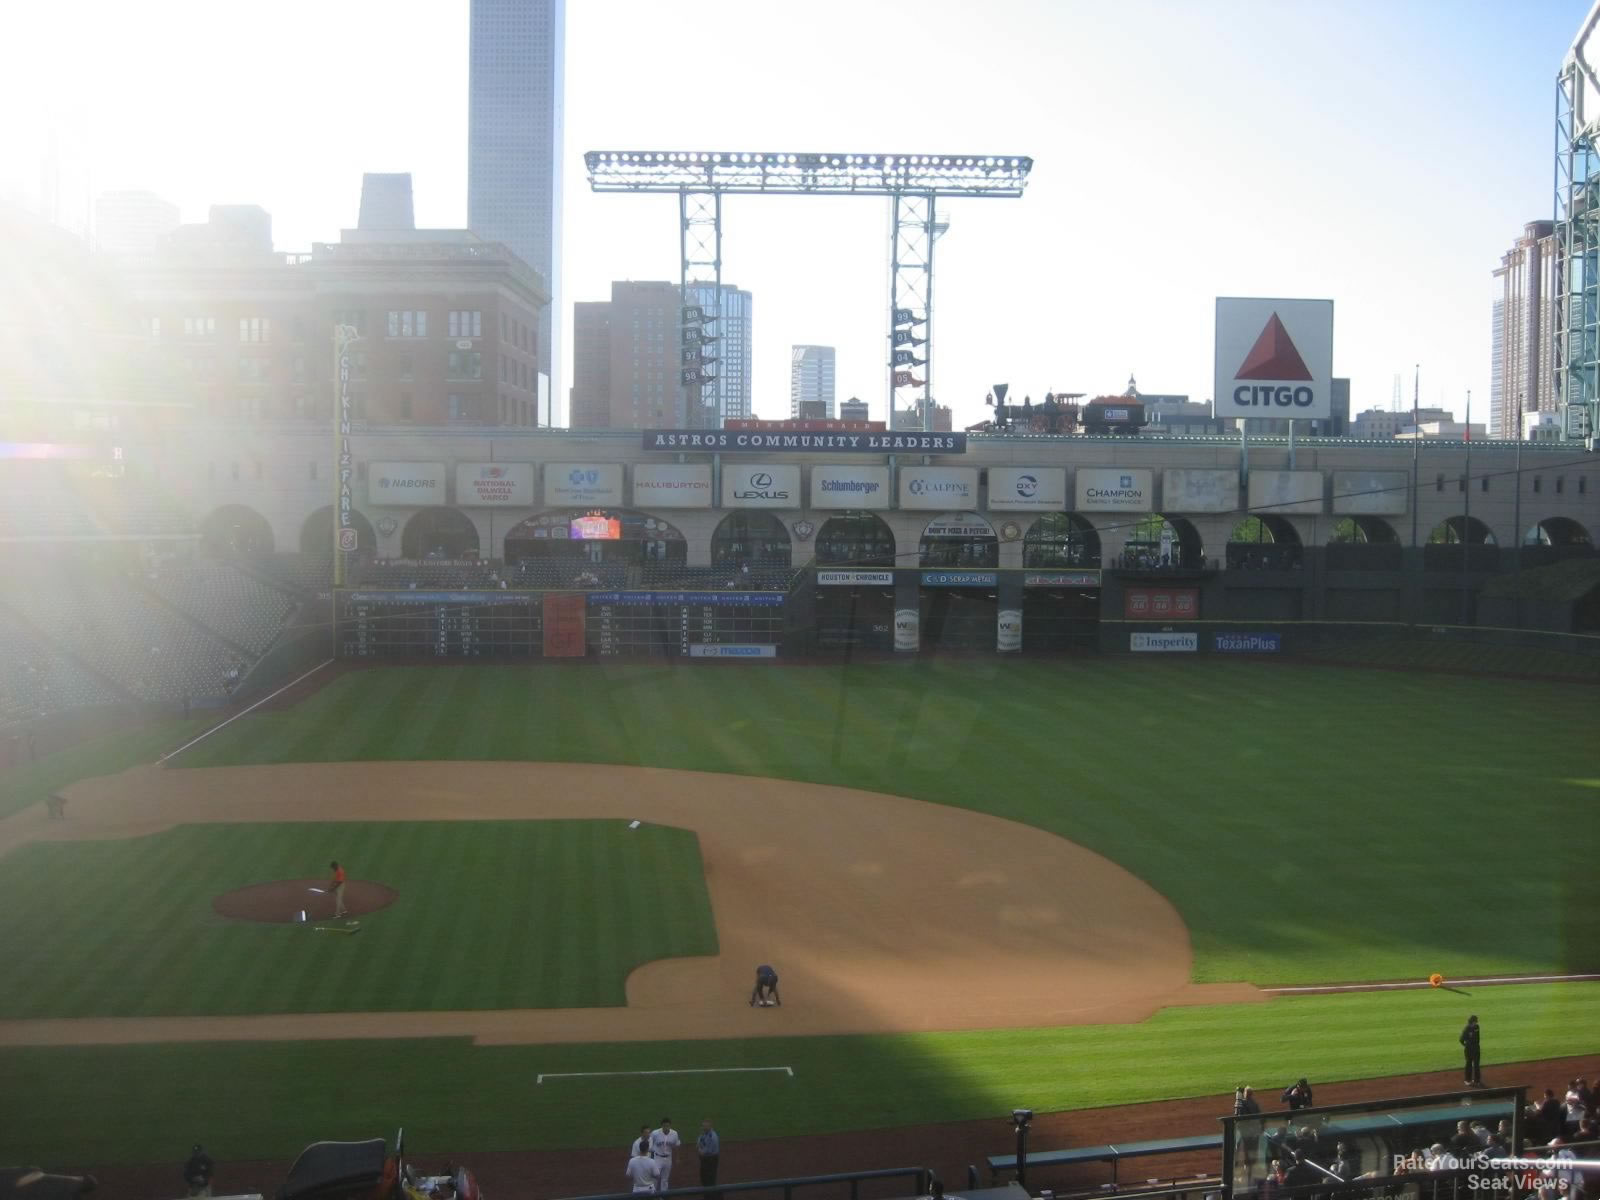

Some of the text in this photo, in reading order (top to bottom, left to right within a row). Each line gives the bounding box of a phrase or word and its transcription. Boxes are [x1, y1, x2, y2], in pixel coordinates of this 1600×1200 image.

[685, 351, 697, 360] 97
[897, 353, 909, 362] 04
[685, 371, 697, 380] 98
[897, 374, 908, 383] 05
[1233, 385, 1314, 407] CITGO
[655, 434, 954, 448] ASTROS COMMUNITY LEADERS
[392, 479, 436, 489] NABORS
[821, 480, 880, 494] Schlumberger
[925, 483, 969, 492] CALPINE
[341, 469, 350, 526] FARE
[734, 491, 788, 500] LEXUS
[1086, 488, 1142, 498] CHAMPION
[821, 574, 889, 582] HOUSTON CHRONICLE
[1146, 636, 1196, 648] Insperity
[1217, 636, 1276, 649] TexanPlus
